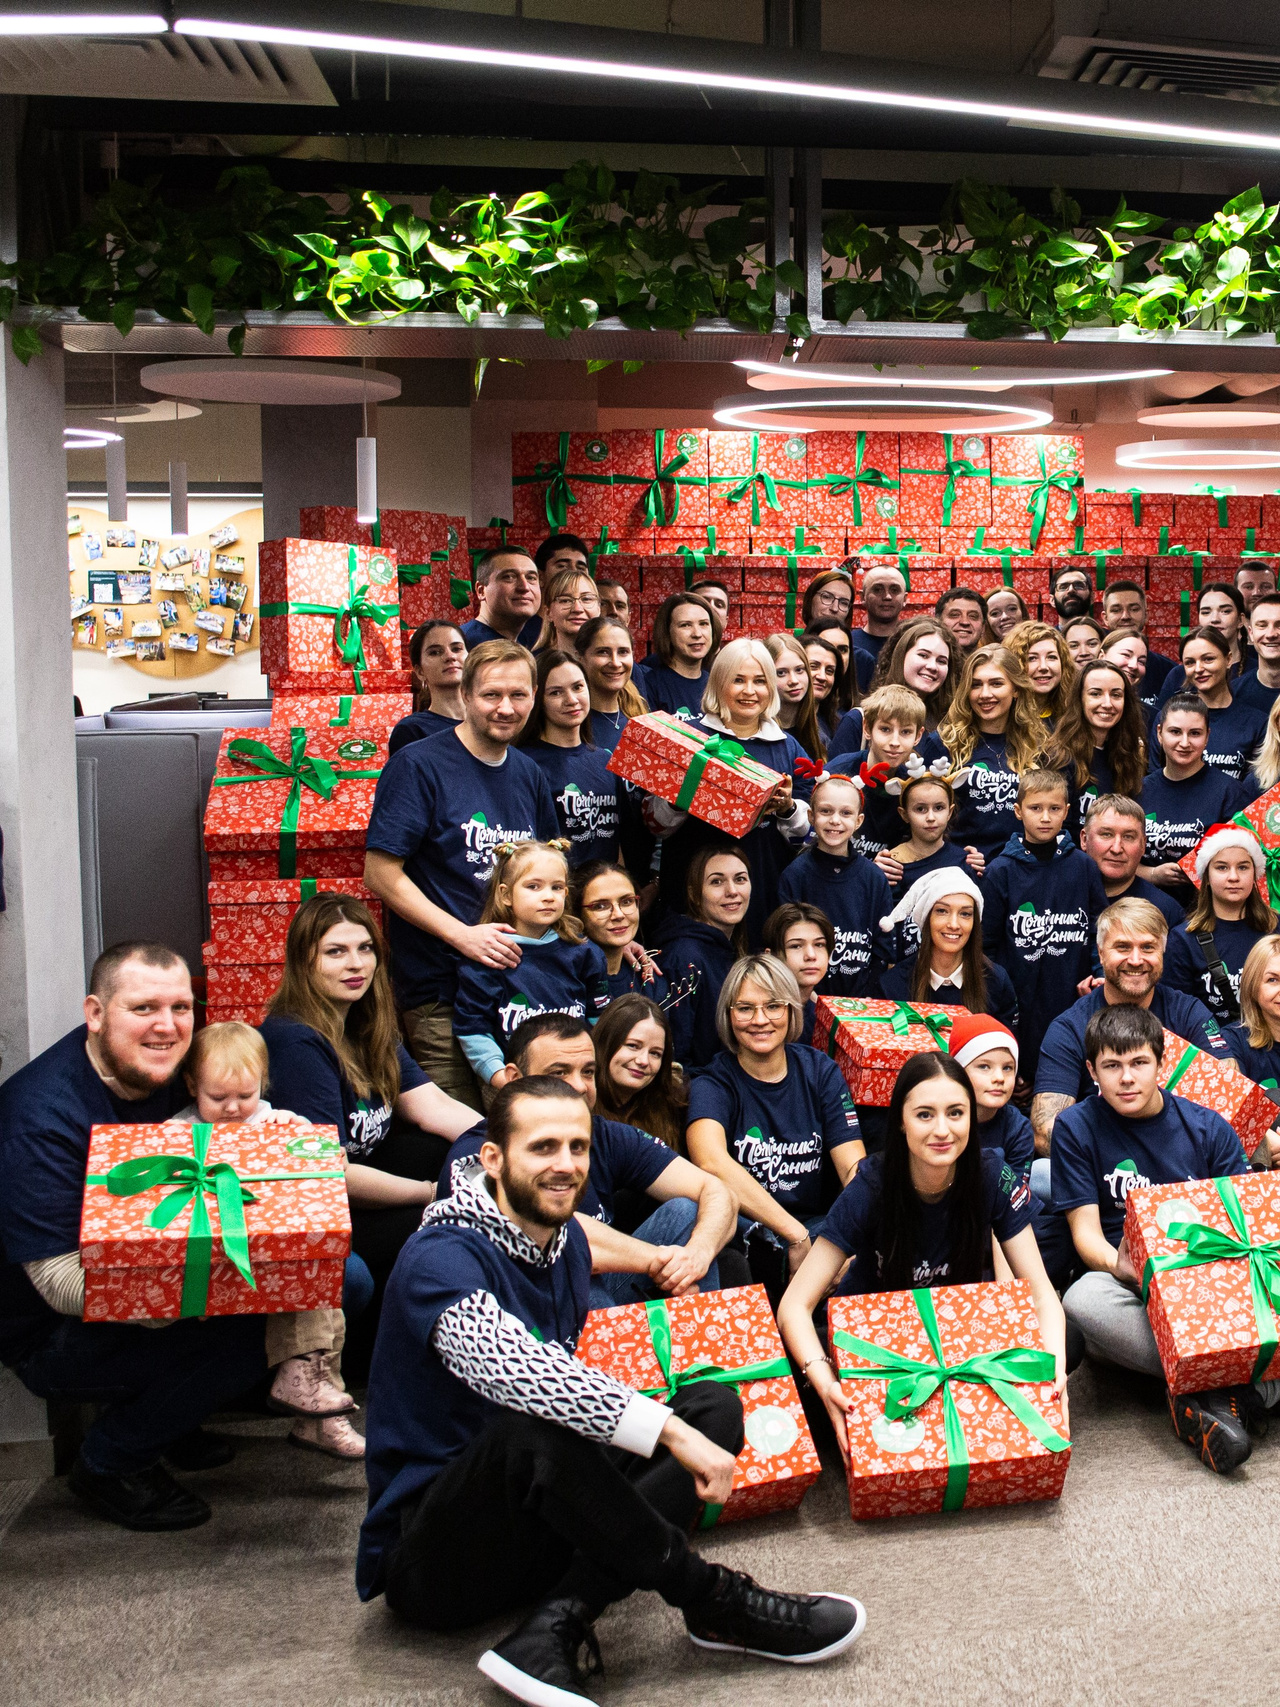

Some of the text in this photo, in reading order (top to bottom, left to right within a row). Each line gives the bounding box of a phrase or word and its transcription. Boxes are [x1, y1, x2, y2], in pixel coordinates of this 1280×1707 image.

[967, 765, 1020, 789] Помічн
[1009, 909, 1080, 937] Помічник
[734, 1134, 815, 1166] Помічник
[762, 1155, 821, 1183] Санти
